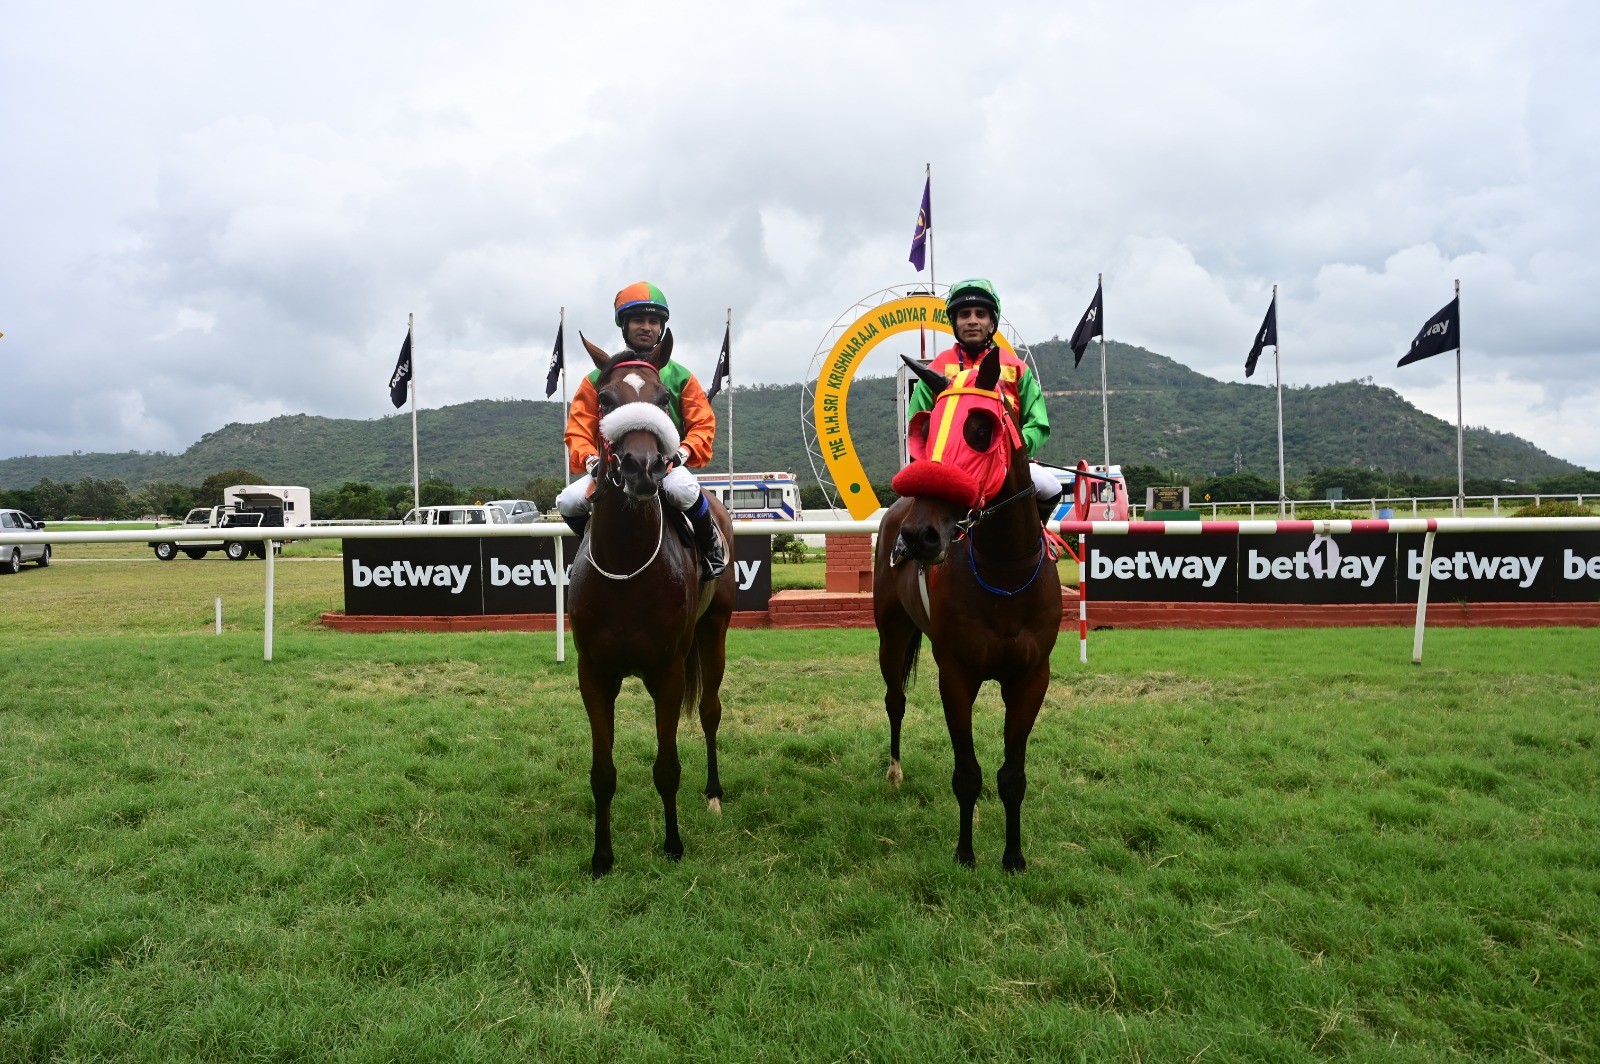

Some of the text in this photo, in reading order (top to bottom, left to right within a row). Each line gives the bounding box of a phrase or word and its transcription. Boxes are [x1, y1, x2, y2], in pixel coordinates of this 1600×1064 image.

[878, 307, 927, 330] WADIYAR
[826, 322, 880, 390] KRISHNARAJA
[823, 394, 840, 434] H.H.SRI
[829, 437, 847, 460] THE
[1091, 548, 1227, 588] betway
[1314, 540, 1328, 571] 1
[1408, 549, 1544, 588] betway
[352, 559, 471, 594] betway
